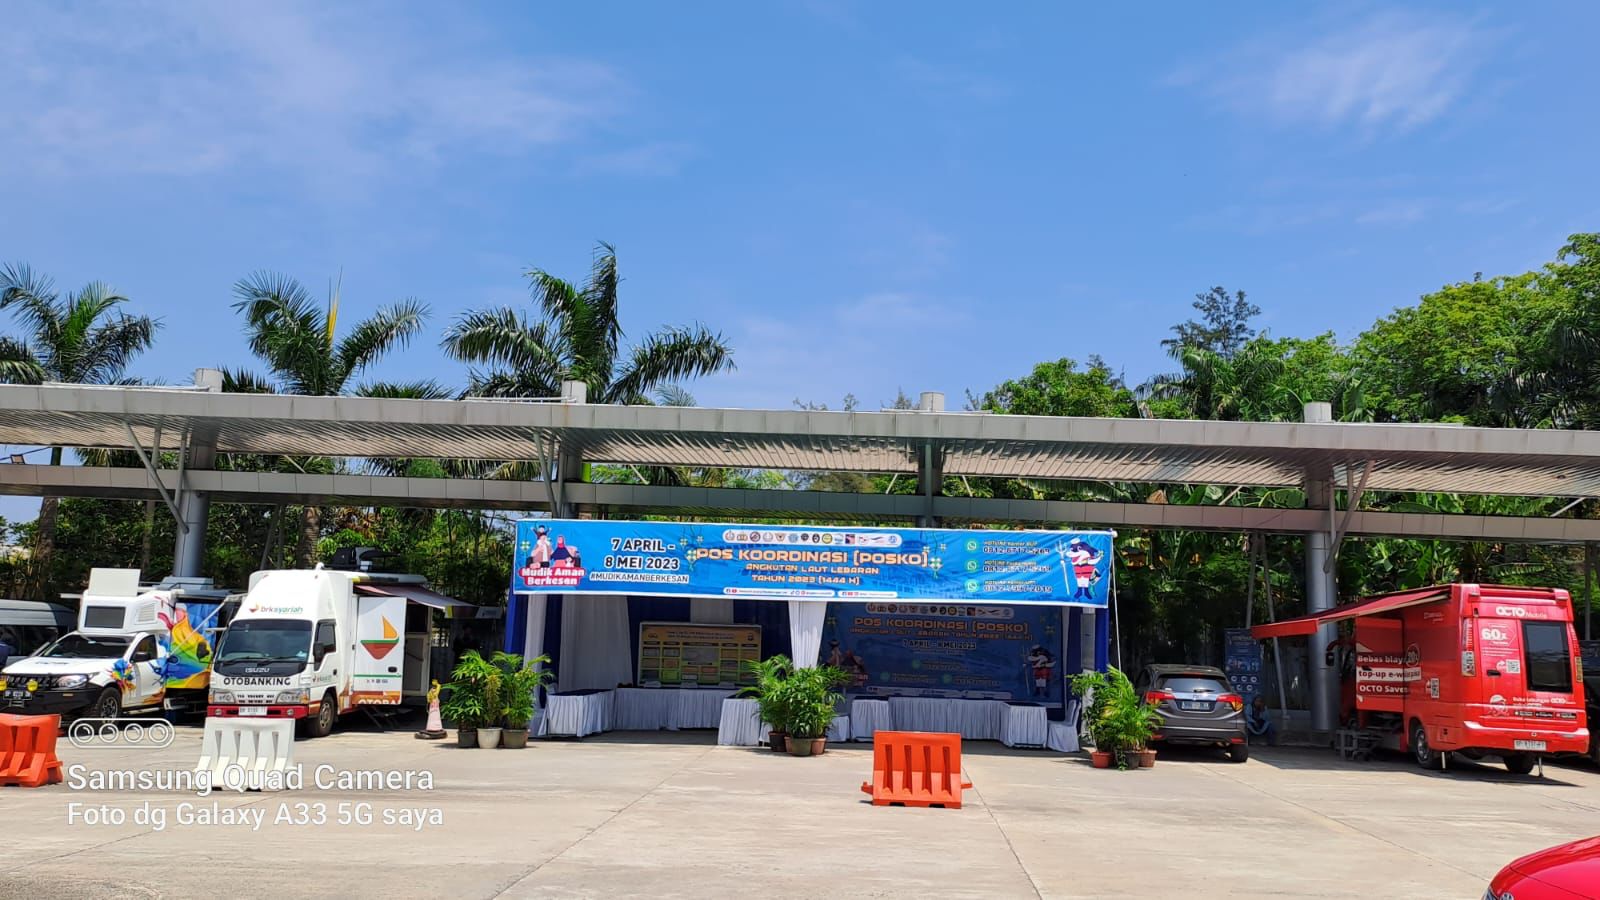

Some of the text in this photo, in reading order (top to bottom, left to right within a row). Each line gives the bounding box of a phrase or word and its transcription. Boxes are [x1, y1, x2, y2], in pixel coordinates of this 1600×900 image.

[612, 538, 618, 550] 7
[624, 539, 665, 551] APRIL
[696, 549, 929, 566] POS KOORDINASI (POSKO)
[604, 557, 679, 570] 8 MEI 2023
[746, 563, 879, 574] ANGKUTAN LAUT LEBARAN
[521, 567, 585, 577] Mudik Aman
[527, 576, 578, 586] Berkesan
[589, 573, 689, 583] #MUDIKAMANBERKESAN
[752, 574, 860, 585] TAHUN 2023 (1444 H)
[1495, 606, 1526, 617] OCTO
[854, 617, 1029, 634] POS KOORDINASI (POSKO)
[1481, 628, 1508, 641] 60x
[1357, 655, 1383, 663] Bebas
[1358, 670, 1386, 679] top-up
[223, 677, 291, 686] OTOBANKING
